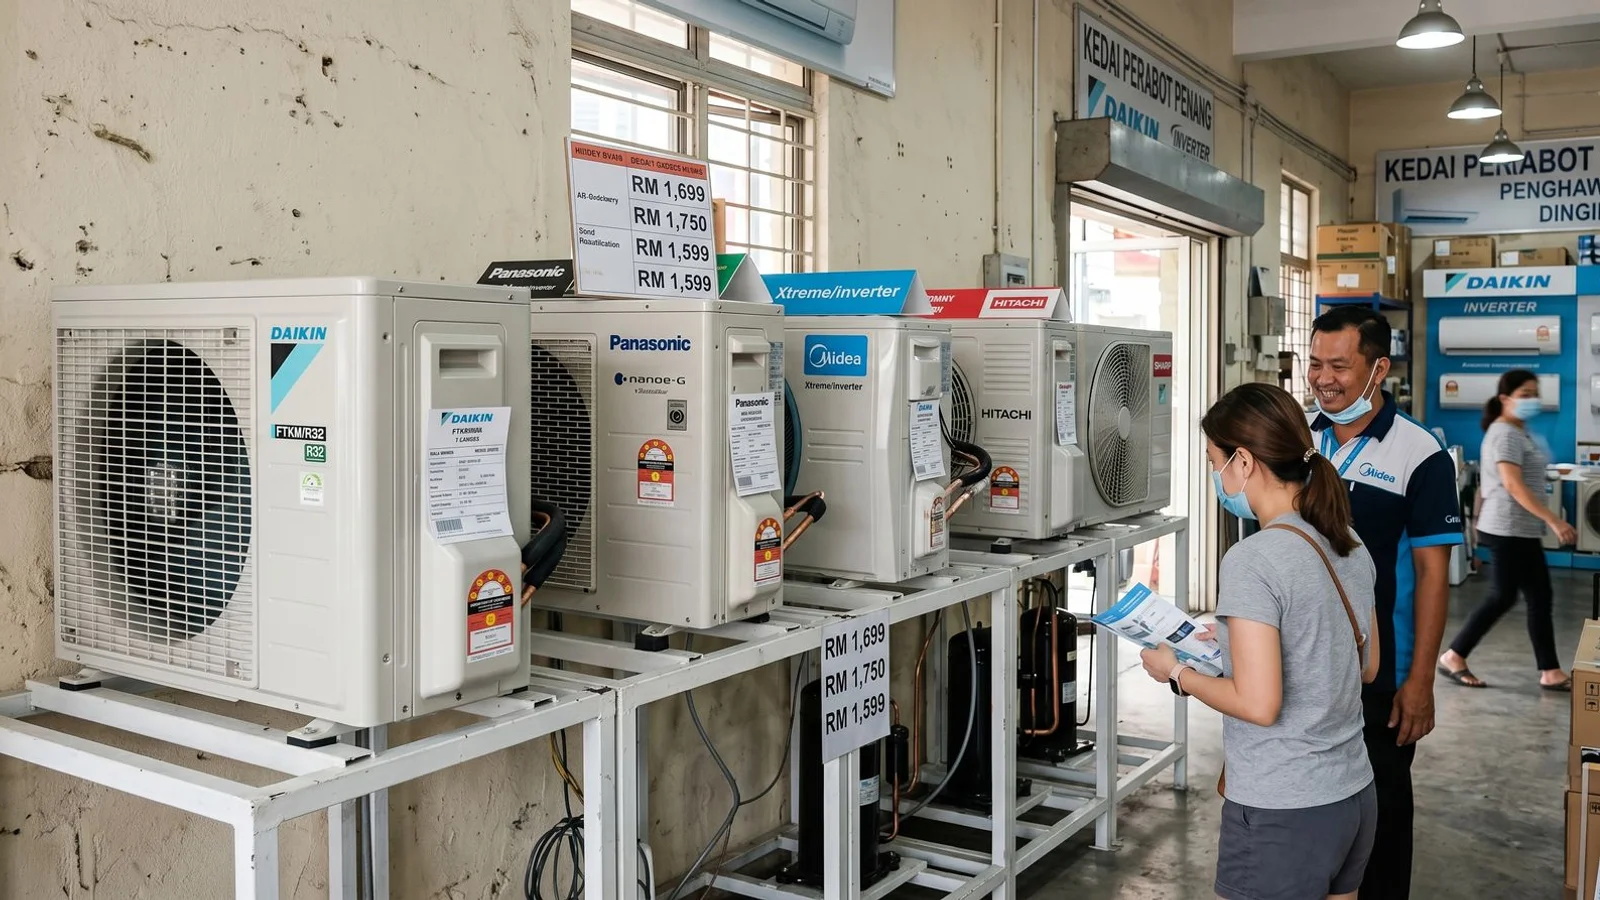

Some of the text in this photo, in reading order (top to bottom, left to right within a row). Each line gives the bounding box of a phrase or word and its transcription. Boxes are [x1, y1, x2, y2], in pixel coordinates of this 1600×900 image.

[1084, 23, 1212, 131] KEDAI PERABOT PENANG
[1104, 94, 1160, 141] DAIKIN
[1173, 129, 1210, 162] INVERTER
[1385, 155, 1455, 183] KEDAI
[632, 175, 705, 202] RM 1,699
[1500, 177, 1600, 200] PENGHAW
[634, 207, 707, 232] RM 1,750
[1539, 203, 1600, 223] DINGI
[636, 238, 710, 262] RM 1,599
[488, 265, 565, 279] Panasonic
[638, 270, 712, 293] RM 1,599
[1466, 275, 1551, 290] DAIKIN
[775, 285, 901, 300] Xtreme/inverter
[994, 299, 1045, 307] HITACHI
[1464, 301, 1538, 313] INVERTER
[270, 326, 327, 340] DAIKIN
[610, 334, 691, 351] Panasonic
[810, 348, 861, 367] Midea
[1154, 361, 1171, 370] SHARP
[629, 375, 686, 385] nanoe-G
[735, 397, 769, 408] Panasonic
[452, 413, 493, 424] DAIKIN
[981, 408, 1032, 420] HITACHI
[276, 425, 324, 440] FTKM/R32
[306, 446, 324, 458] R32
[1360, 464, 1396, 483] Midea
[825, 623, 885, 660] RM 1,699
[826, 658, 885, 698] RM 1,750
[826, 693, 885, 735] RM 1,599
